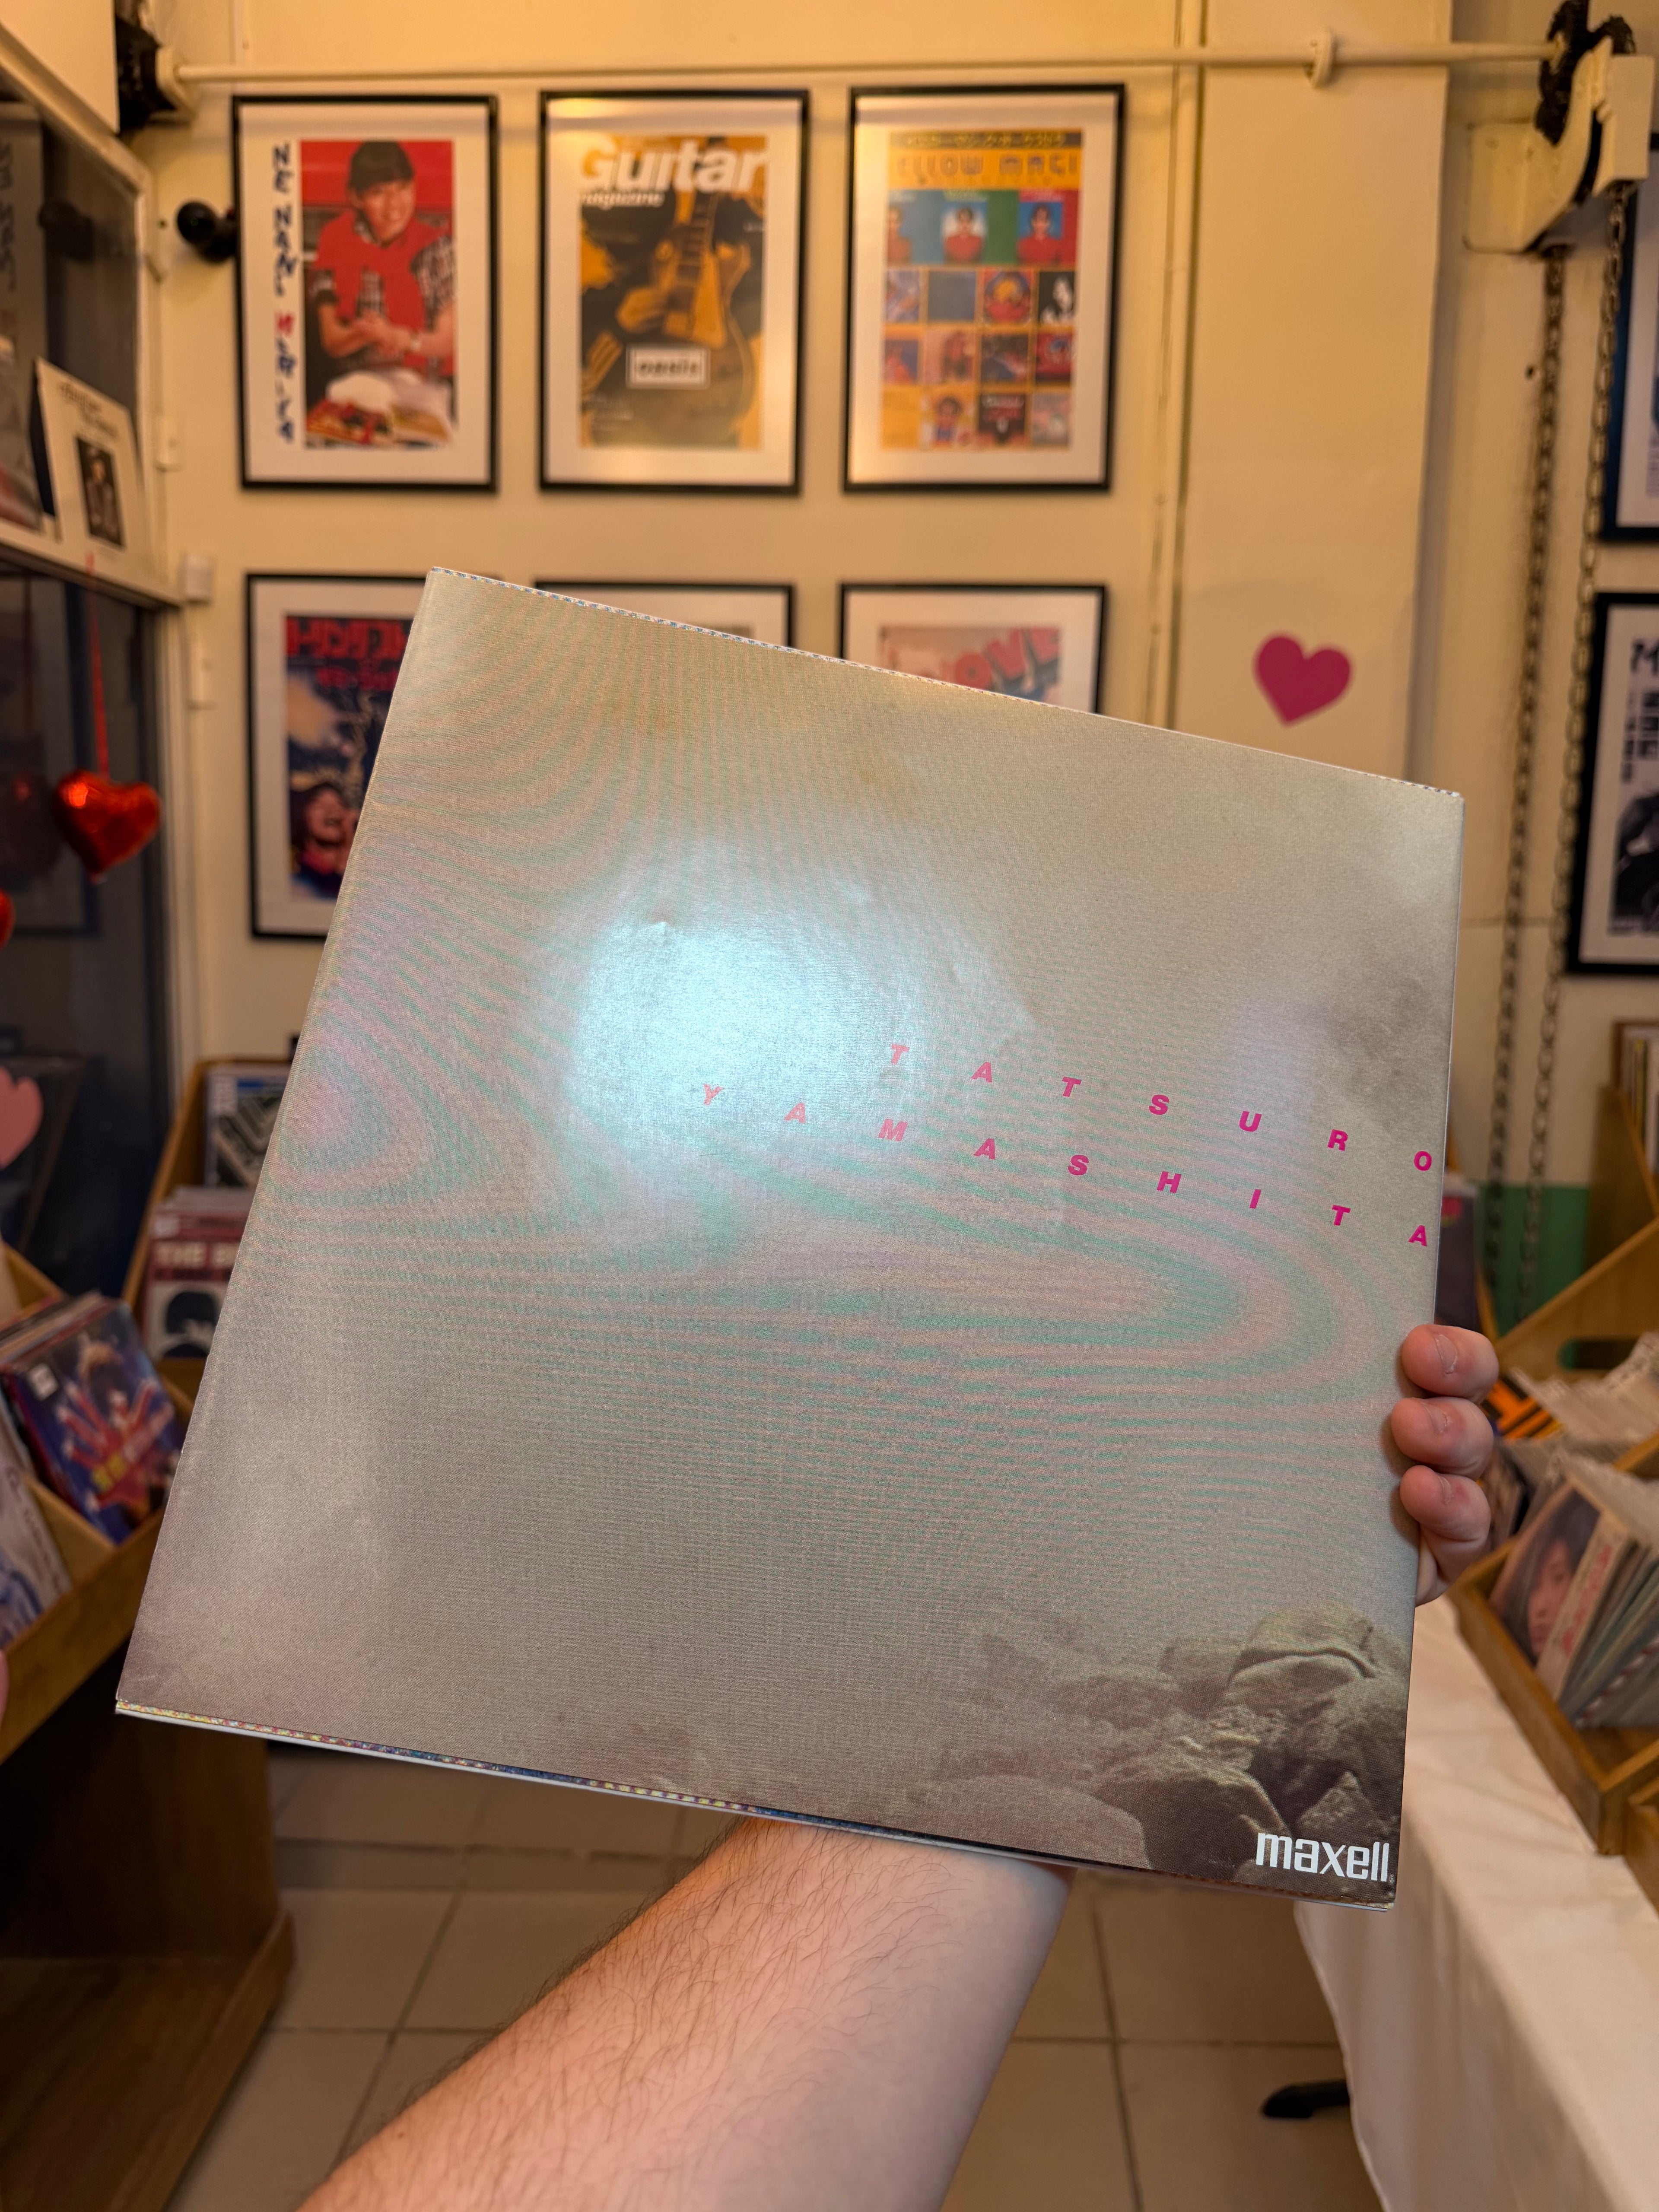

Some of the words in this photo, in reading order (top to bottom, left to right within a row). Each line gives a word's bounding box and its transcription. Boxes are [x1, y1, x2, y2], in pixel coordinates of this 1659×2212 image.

[579, 132, 768, 193] Guitar
[891, 1043, 1433, 1172] TATSURO
[703, 1084, 1427, 1247] YAMASHITA
[1256, 1832, 1389, 1882] maxell
